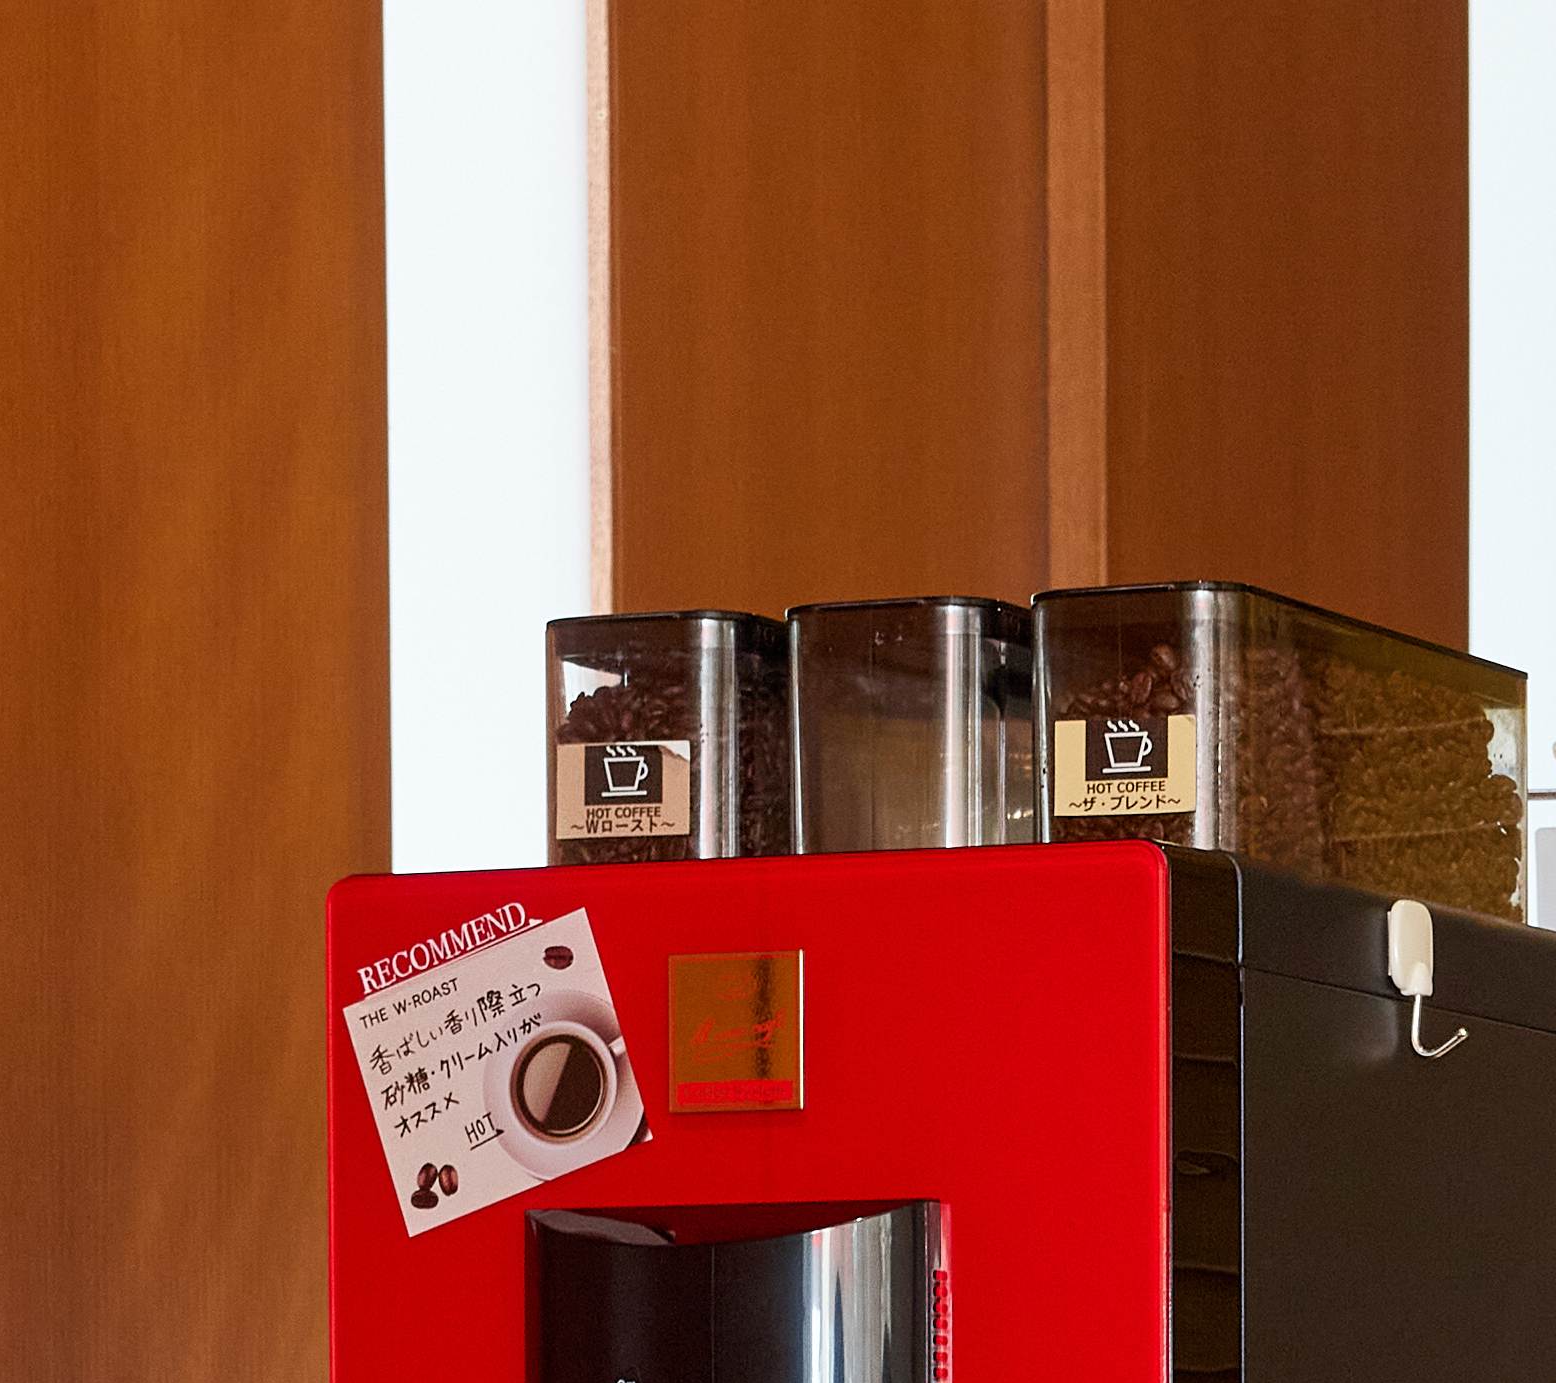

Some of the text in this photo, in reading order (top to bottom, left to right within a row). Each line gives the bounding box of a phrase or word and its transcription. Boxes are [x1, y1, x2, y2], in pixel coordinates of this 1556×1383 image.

[1087, 780, 1166, 794] HOT COFFEE
[586, 806, 661, 819] HOT COFFEE
[356, 901, 527, 996] RECOMMEND
[359, 977, 459, 1029] THE W-ROAST
[394, 1092, 460, 1138] オススメ
[464, 1112, 496, 1143] HOT
